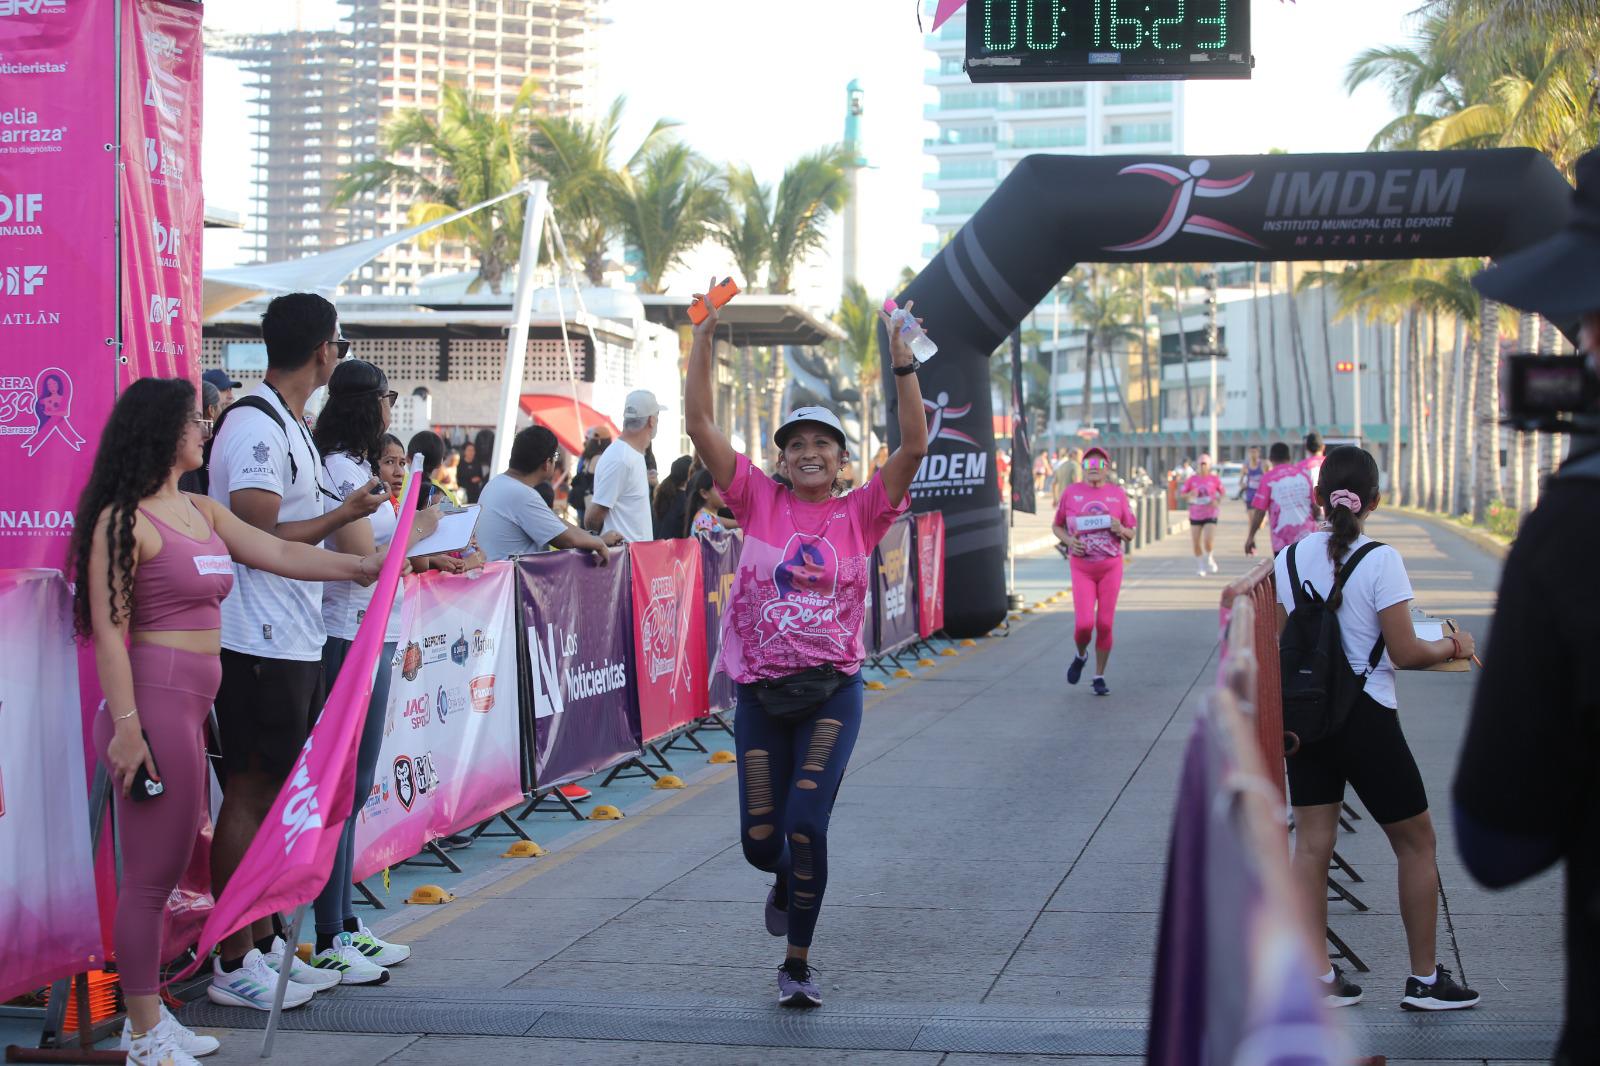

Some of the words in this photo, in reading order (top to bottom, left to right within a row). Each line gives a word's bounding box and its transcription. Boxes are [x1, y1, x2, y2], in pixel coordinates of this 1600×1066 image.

[1264, 167, 1466, 217] IMDEM
[1263, 219, 1320, 232] INSTITUTO
[1321, 218, 1381, 231] MUNICIPAL
[1382, 217, 1403, 229] DEL
[1404, 216, 1454, 229] DEPORTE
[763, 601, 835, 631] Rosa
[560, 628, 578, 657] Los
